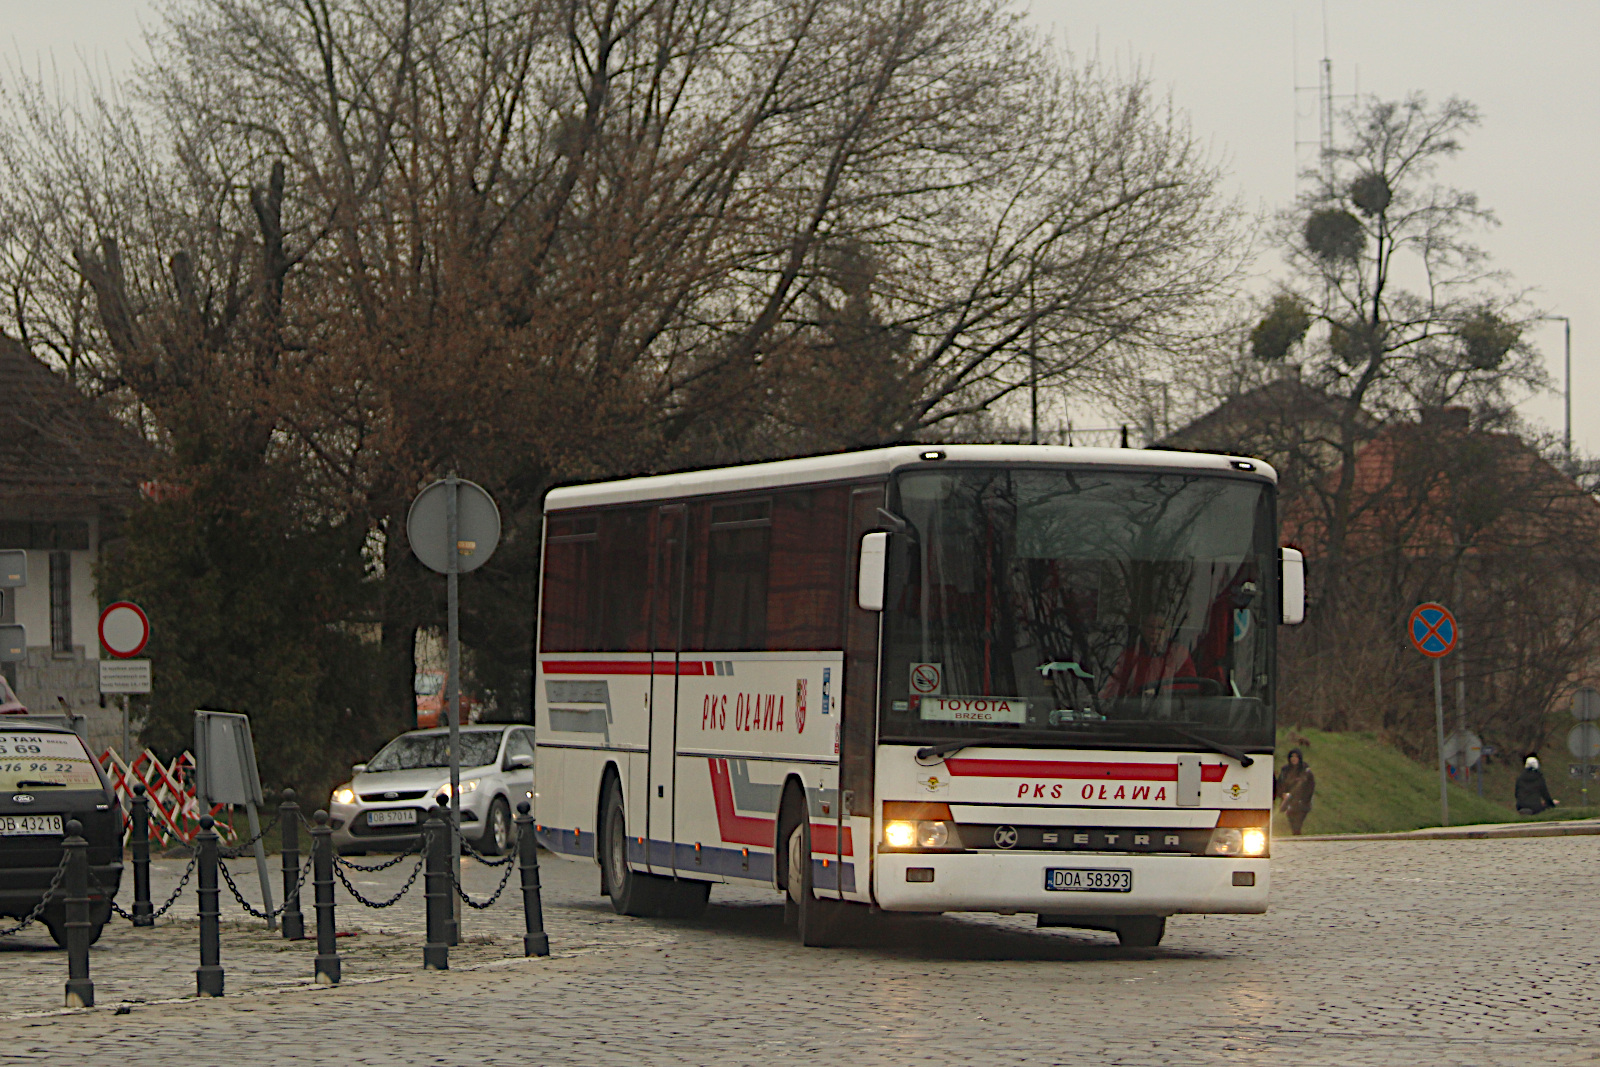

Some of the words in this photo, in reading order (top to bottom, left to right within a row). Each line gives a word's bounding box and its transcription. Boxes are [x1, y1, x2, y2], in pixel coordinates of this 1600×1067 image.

[701, 693, 727, 731] PKS
[735, 691, 784, 732] OŁAWA
[938, 699, 1011, 712] TOYOTA
[955, 712, 993, 720] BRZEG
[14, 744, 41, 754] 69
[0, 762, 22, 772] 16
[29, 762, 48, 772] 96
[54, 763, 73, 773] 22
[1017, 783, 1063, 799] PKS
[1081, 783, 1167, 801] OŁAWA
[387, 810, 413, 821] 5701A
[21, 816, 61, 831] 43218
[1042, 832, 1180, 846] SETRA
[1055, 871, 1081, 887] DOA
[1086, 872, 1129, 888] 58393
